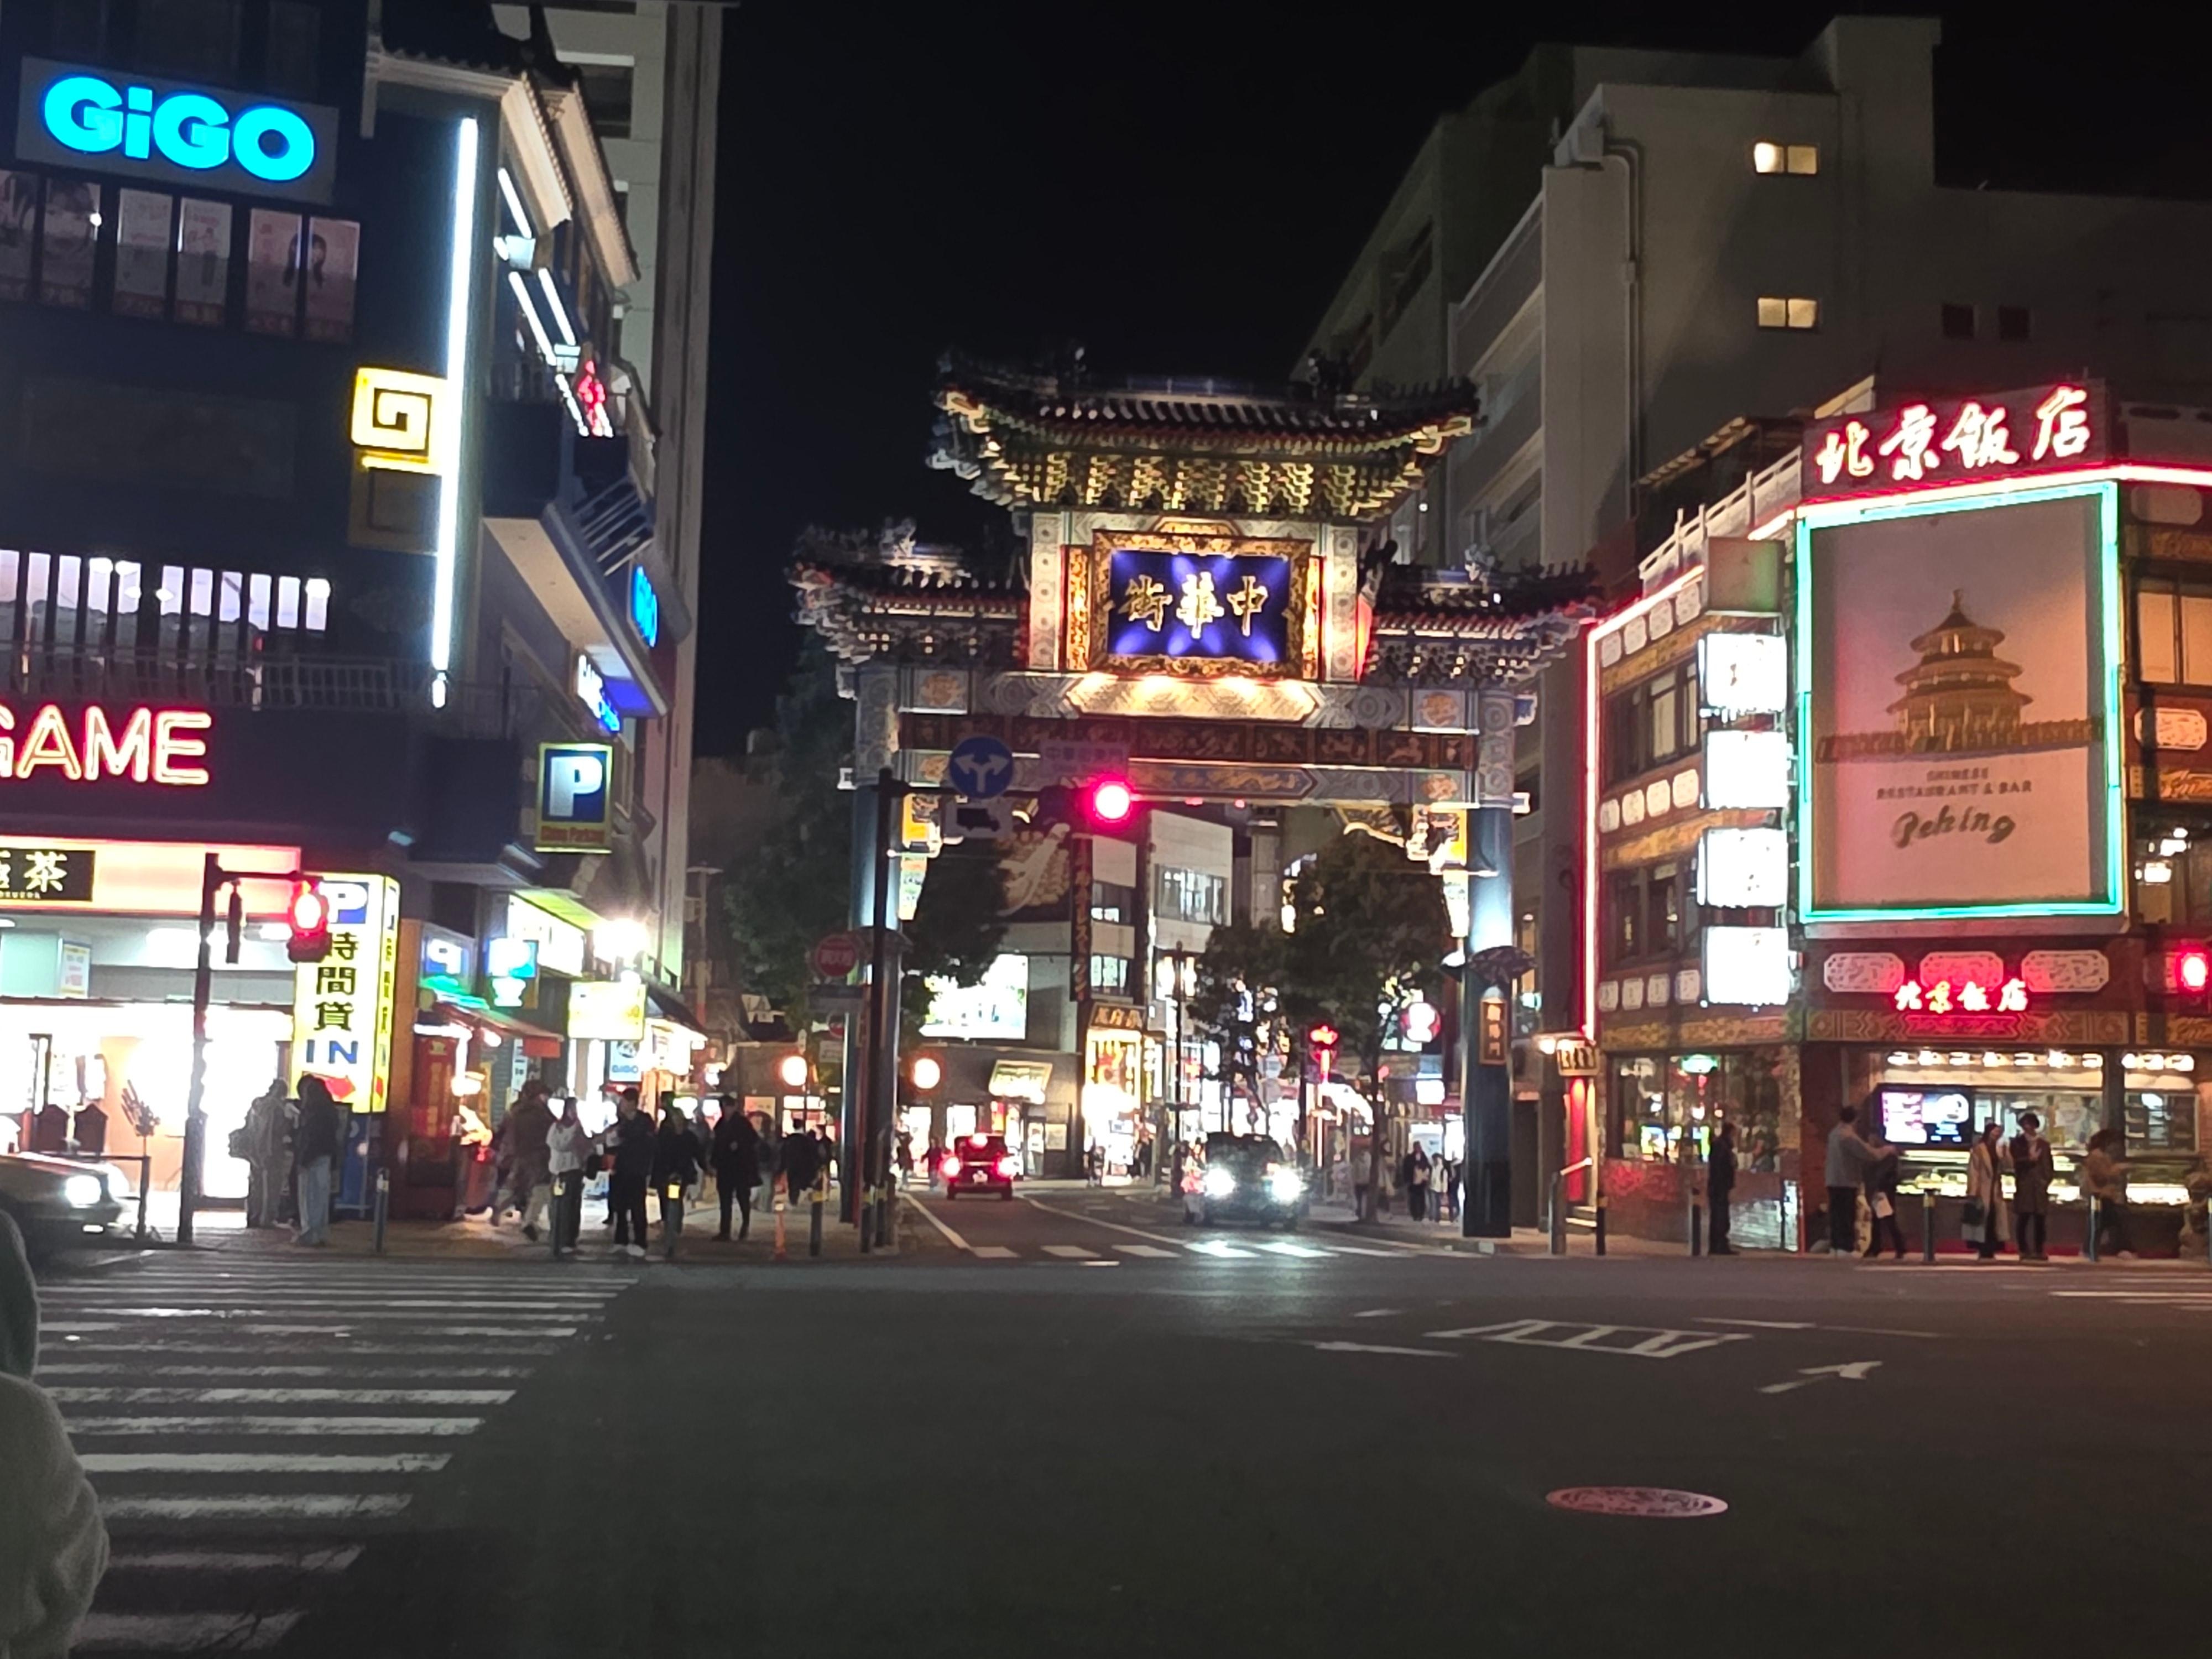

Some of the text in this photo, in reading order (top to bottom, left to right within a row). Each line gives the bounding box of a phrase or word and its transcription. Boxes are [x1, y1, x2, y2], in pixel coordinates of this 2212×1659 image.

[44, 76, 315, 181] GiGO
[1815, 385, 2090, 484] 北京飯店
[0, 704, 212, 785] AME
[549, 756, 602, 817] P
[1877, 783, 1979, 800] RESTAURANT
[1999, 780, 2032, 795] BAR
[1927, 768, 1989, 782] CHINESE
[1890, 805, 2016, 849] Peking
[1895, 978, 2028, 1014] 北京飯店
[306, 1039, 358, 1064] IN
